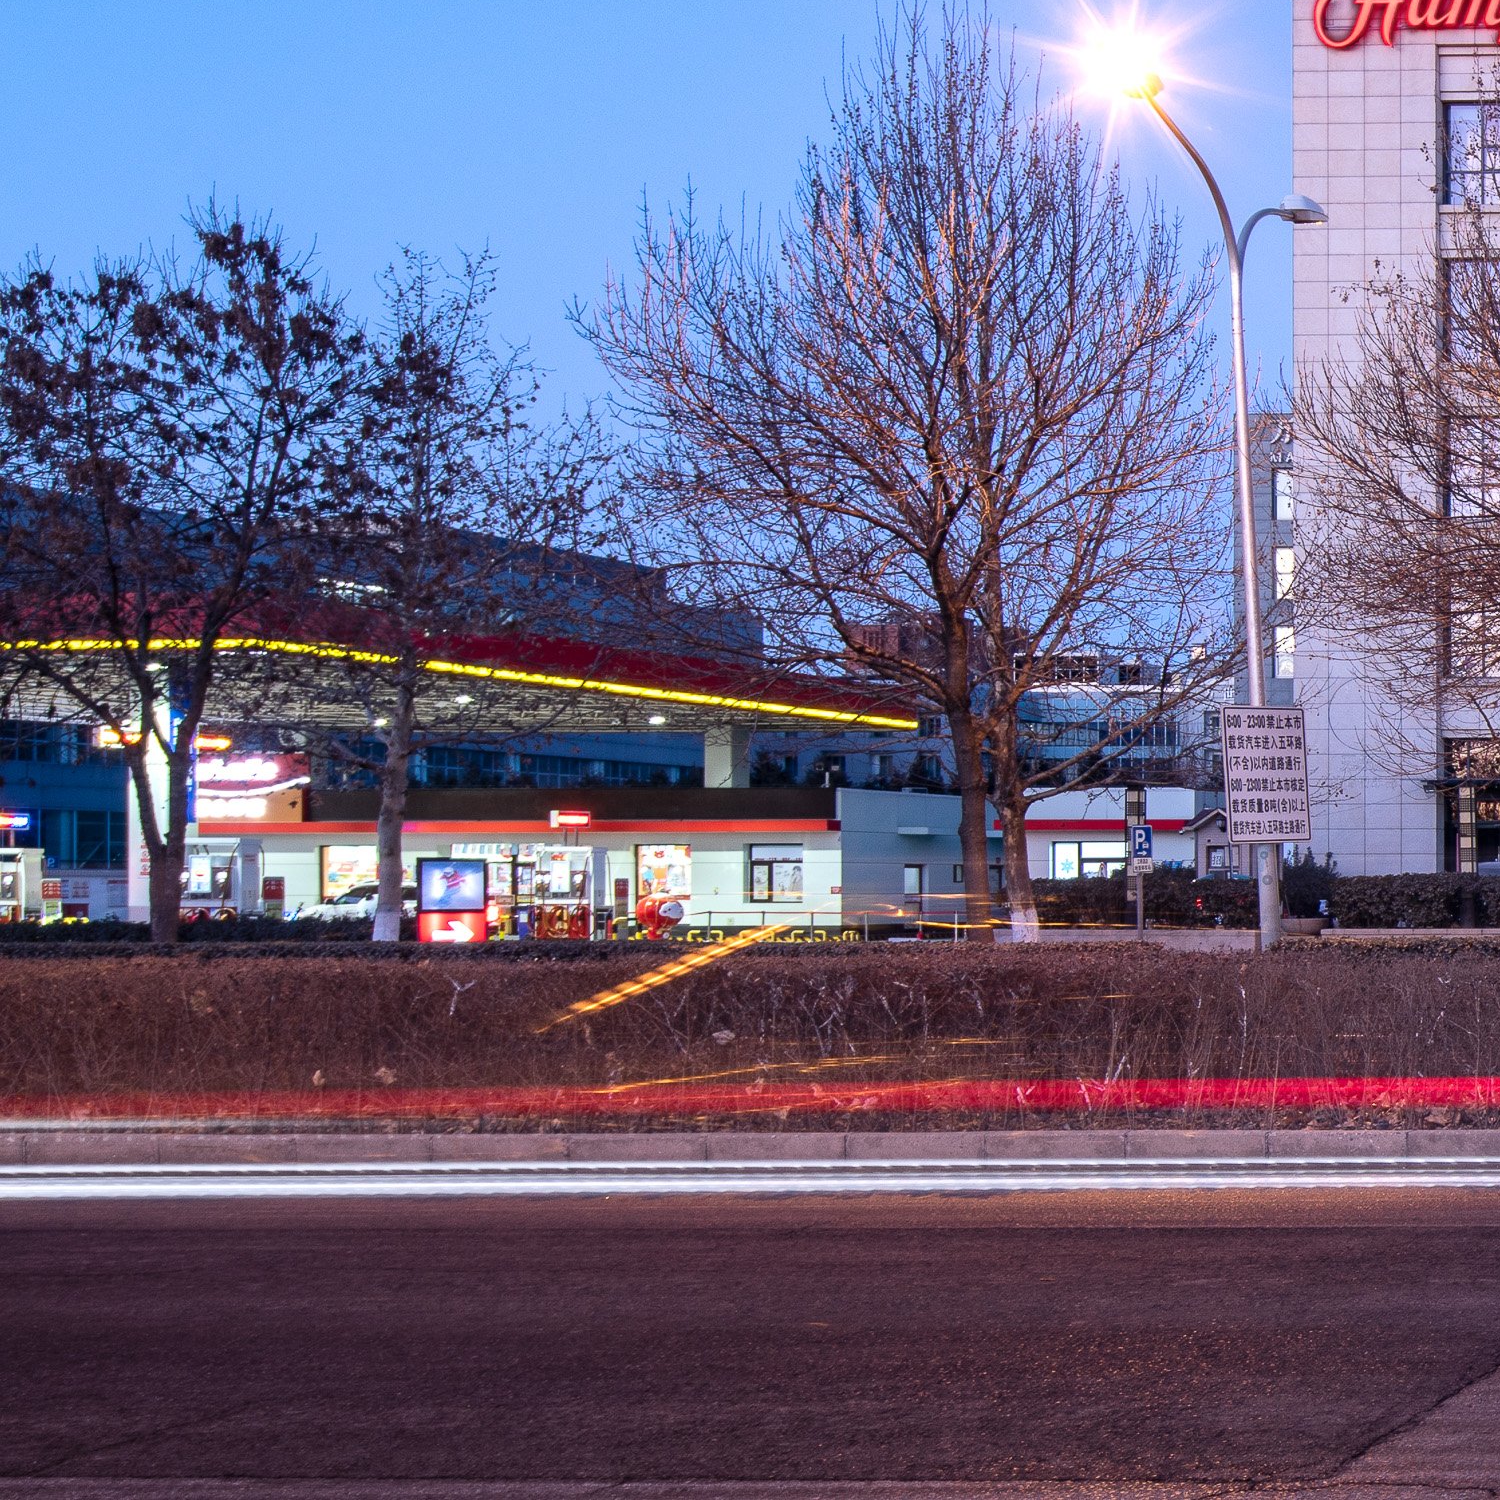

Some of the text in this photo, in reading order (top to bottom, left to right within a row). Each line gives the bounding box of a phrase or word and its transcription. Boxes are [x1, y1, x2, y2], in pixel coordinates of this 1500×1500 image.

[1228, 734, 1303, 750] 载货汽车进入五环路
[1135, 830, 1146, 850] P
